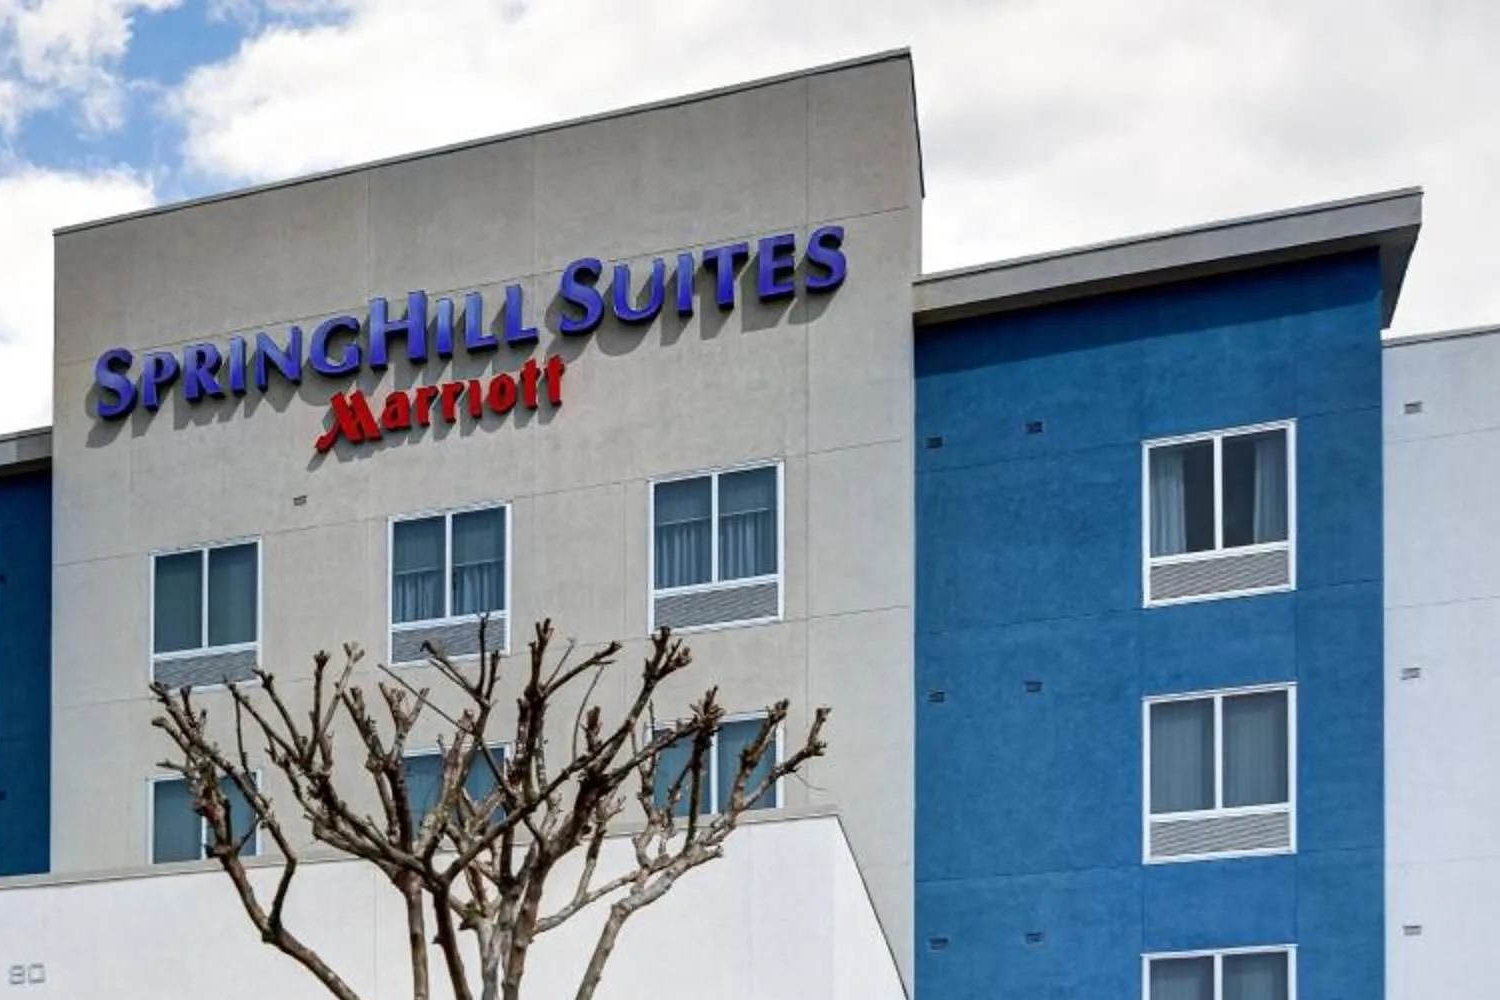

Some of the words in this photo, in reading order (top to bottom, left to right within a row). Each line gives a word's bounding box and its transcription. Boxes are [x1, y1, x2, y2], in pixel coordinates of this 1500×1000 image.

[93, 283, 540, 421] SPRINGHILL
[558, 224, 848, 336] SUITES
[315, 353, 566, 453] Marriott
